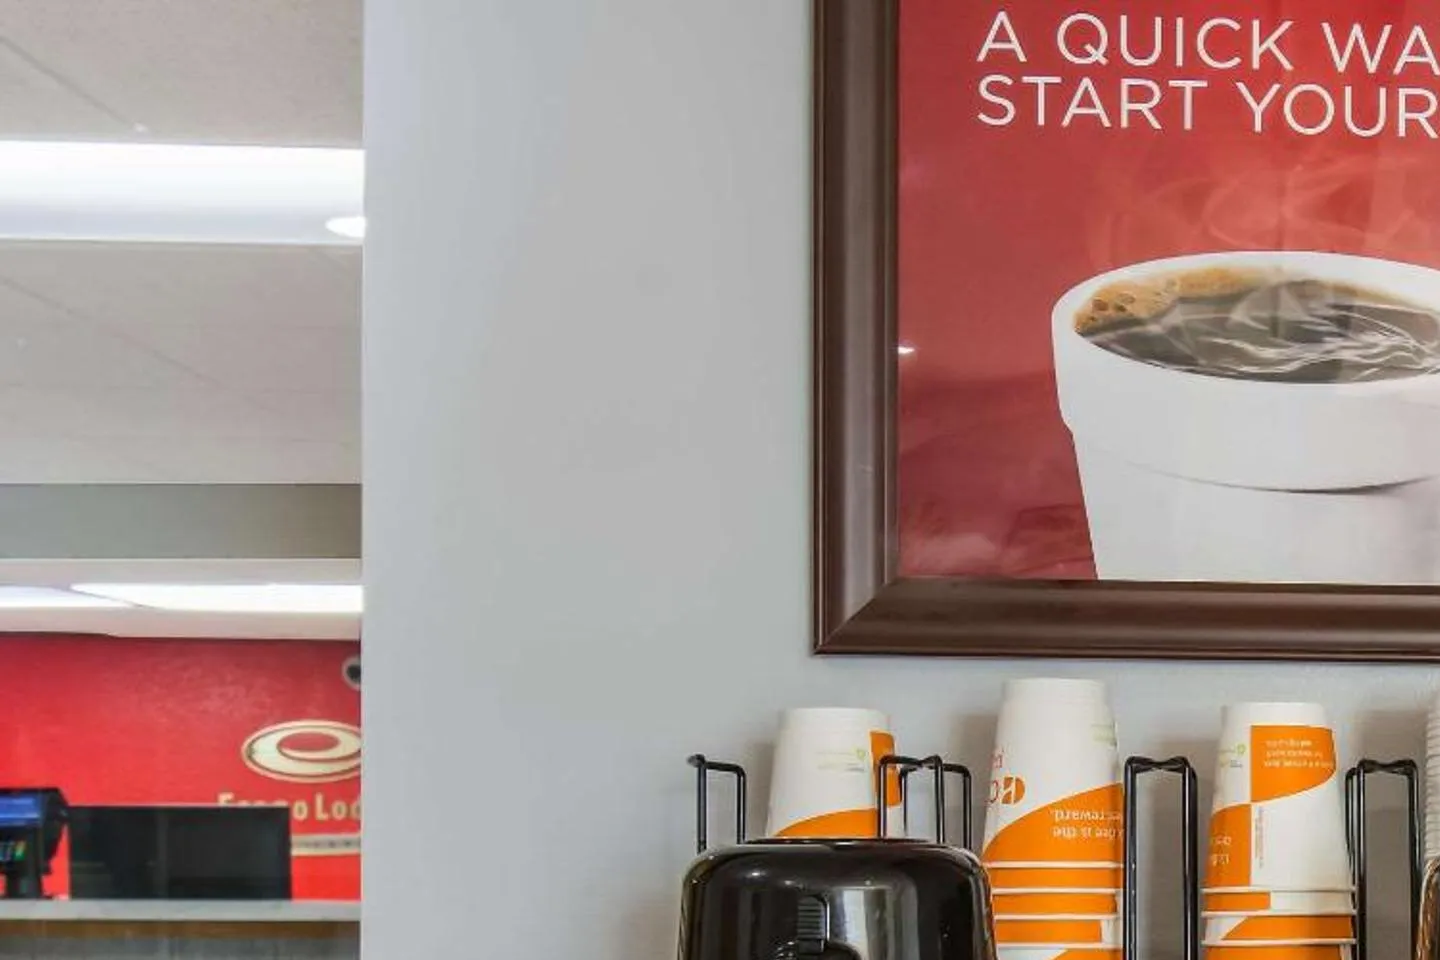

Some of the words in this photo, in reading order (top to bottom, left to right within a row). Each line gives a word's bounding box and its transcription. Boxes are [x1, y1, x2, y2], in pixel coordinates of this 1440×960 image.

[977, 11, 1027, 62] A
[1057, 12, 1294, 71] QUICK
[977, 74, 1208, 130] START
[1235, 81, 1439, 139] YOUR
